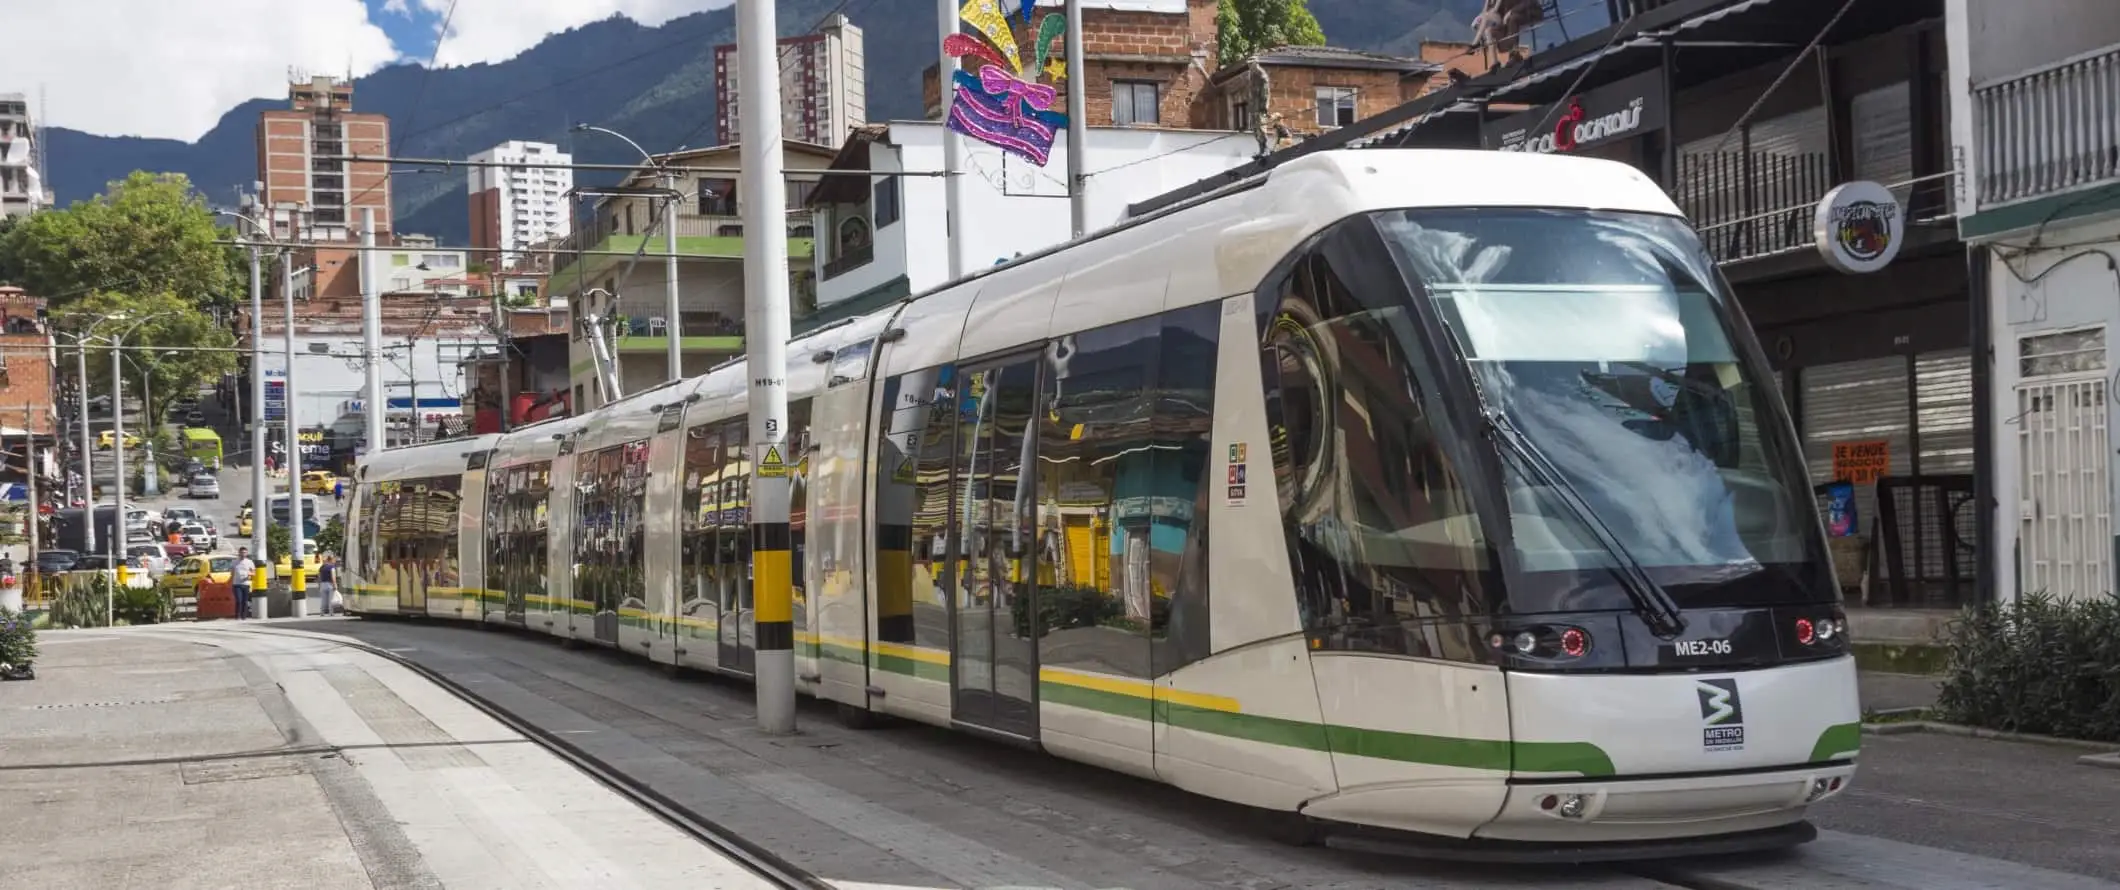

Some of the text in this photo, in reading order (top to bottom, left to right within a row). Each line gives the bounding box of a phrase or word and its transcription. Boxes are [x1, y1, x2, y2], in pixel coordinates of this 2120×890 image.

[265, 369, 288, 377] Mobi
[1675, 639, 1732, 656] ME2-06
[1705, 727, 1742, 739] METRO
